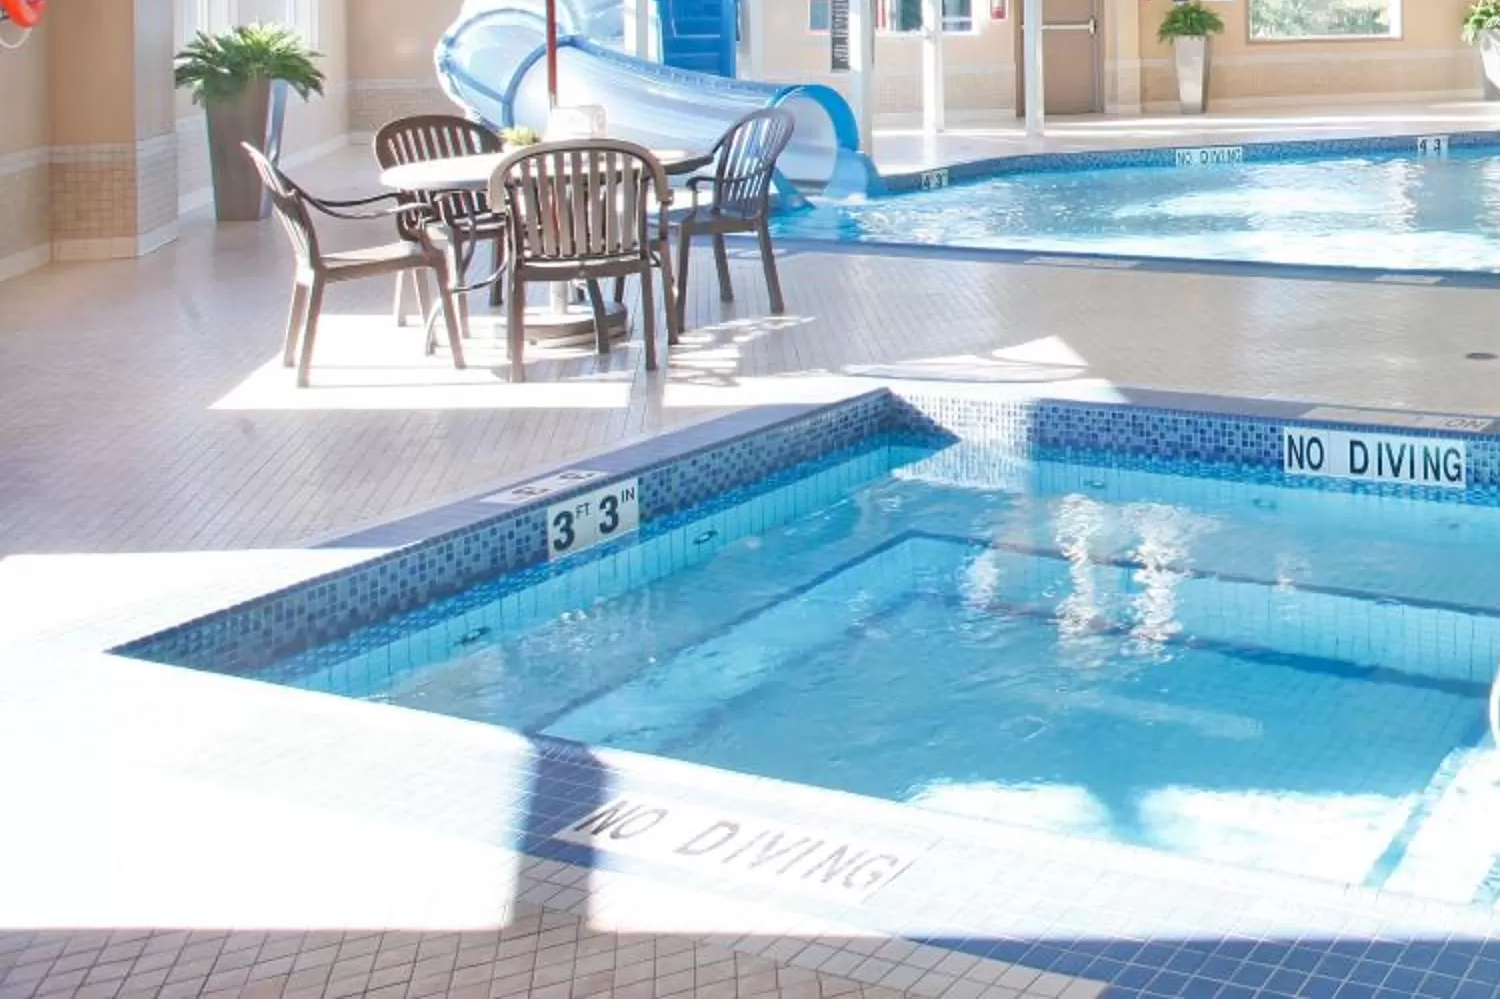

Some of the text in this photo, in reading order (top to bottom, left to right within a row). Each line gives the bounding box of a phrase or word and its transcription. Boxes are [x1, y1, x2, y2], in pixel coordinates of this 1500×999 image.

[1288, 434, 1463, 482] NO DIVING
[552, 487, 635, 551] 3 FT 3 IN
[575, 800, 899, 889] NO DIVING
